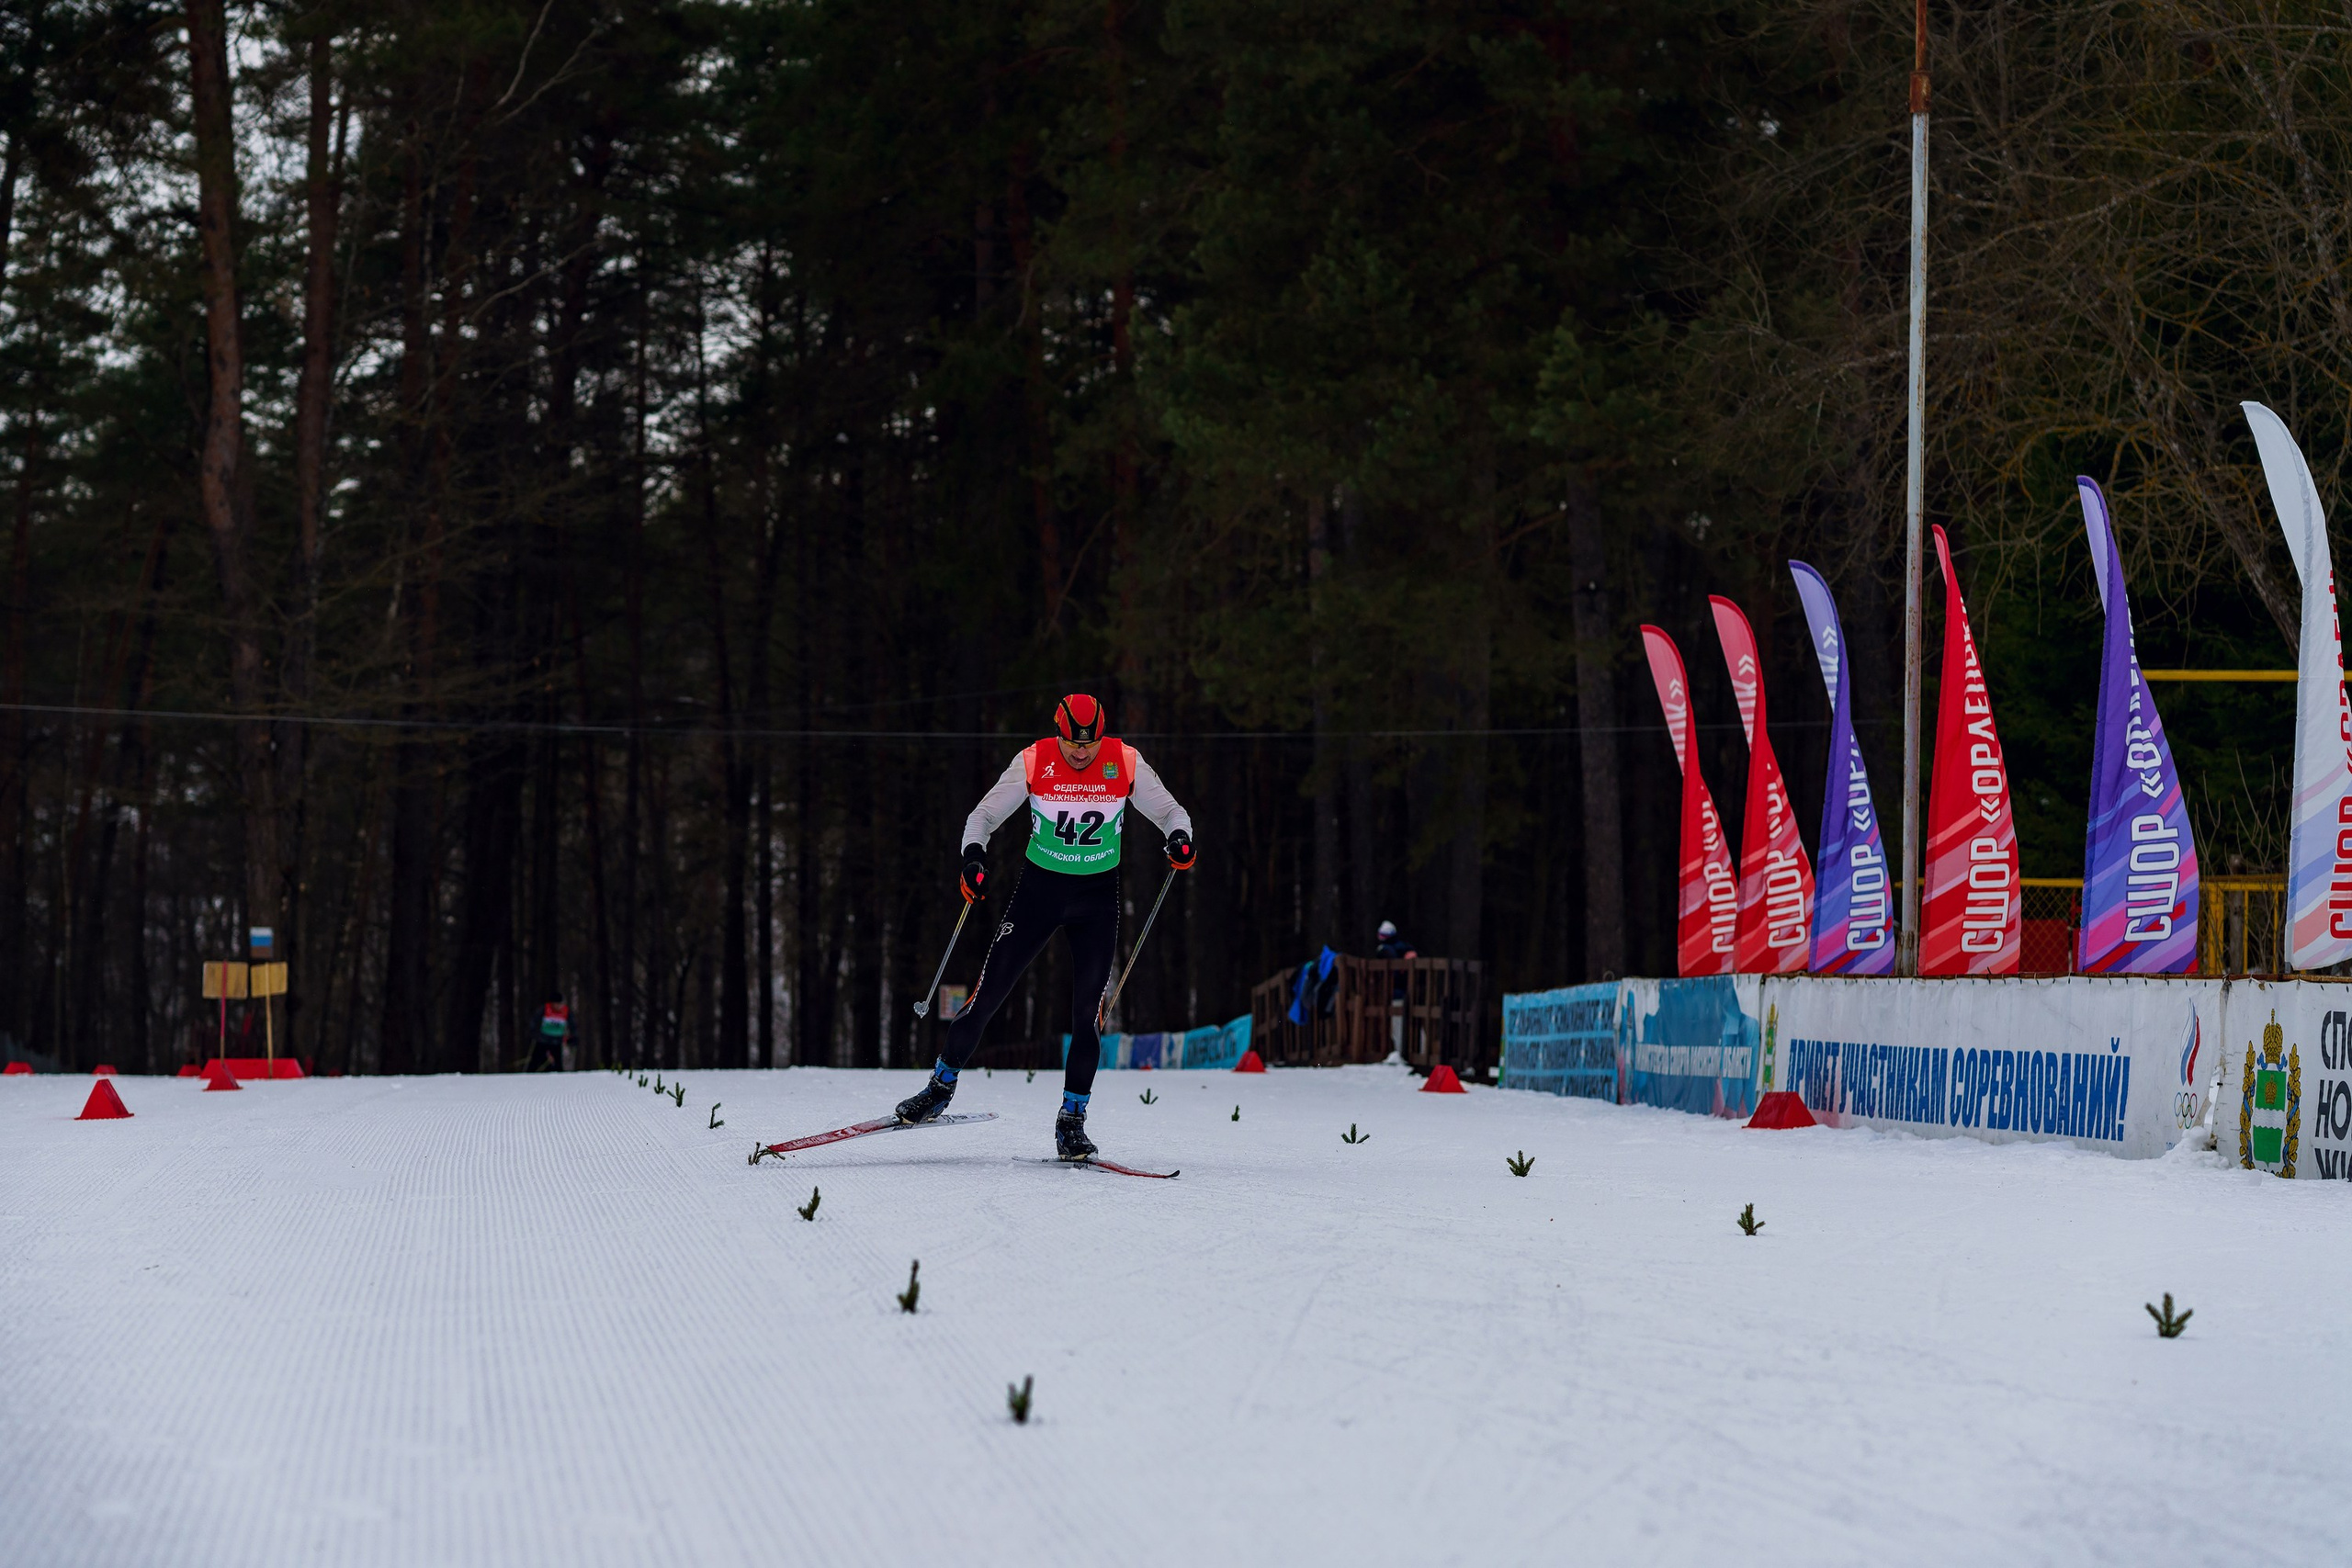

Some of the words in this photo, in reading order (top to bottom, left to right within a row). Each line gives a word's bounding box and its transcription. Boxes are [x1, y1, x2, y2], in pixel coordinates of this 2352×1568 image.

[1041, 794, 1085, 802] ЛЫЖНЫХ
[1087, 795, 1118, 803] ГОНОК
[1053, 784, 1107, 793] ФЕДЕРАЦИЯ
[1054, 810, 1105, 846] 42
[1763, 850, 1806, 949] СШОР
[1846, 842, 1887, 952] СШОР
[1961, 835, 2010, 954] СШОР
[2123, 812, 2180, 942] СШОР
[1785, 1038, 1840, 1112] ПРИВЕТ
[1838, 1042, 1949, 1125] УЧАСТНИКАМ
[1950, 1037, 2131, 1142] СОРЕВНОВАНИЙ!
[2321, 1010, 2352, 1070] СП
